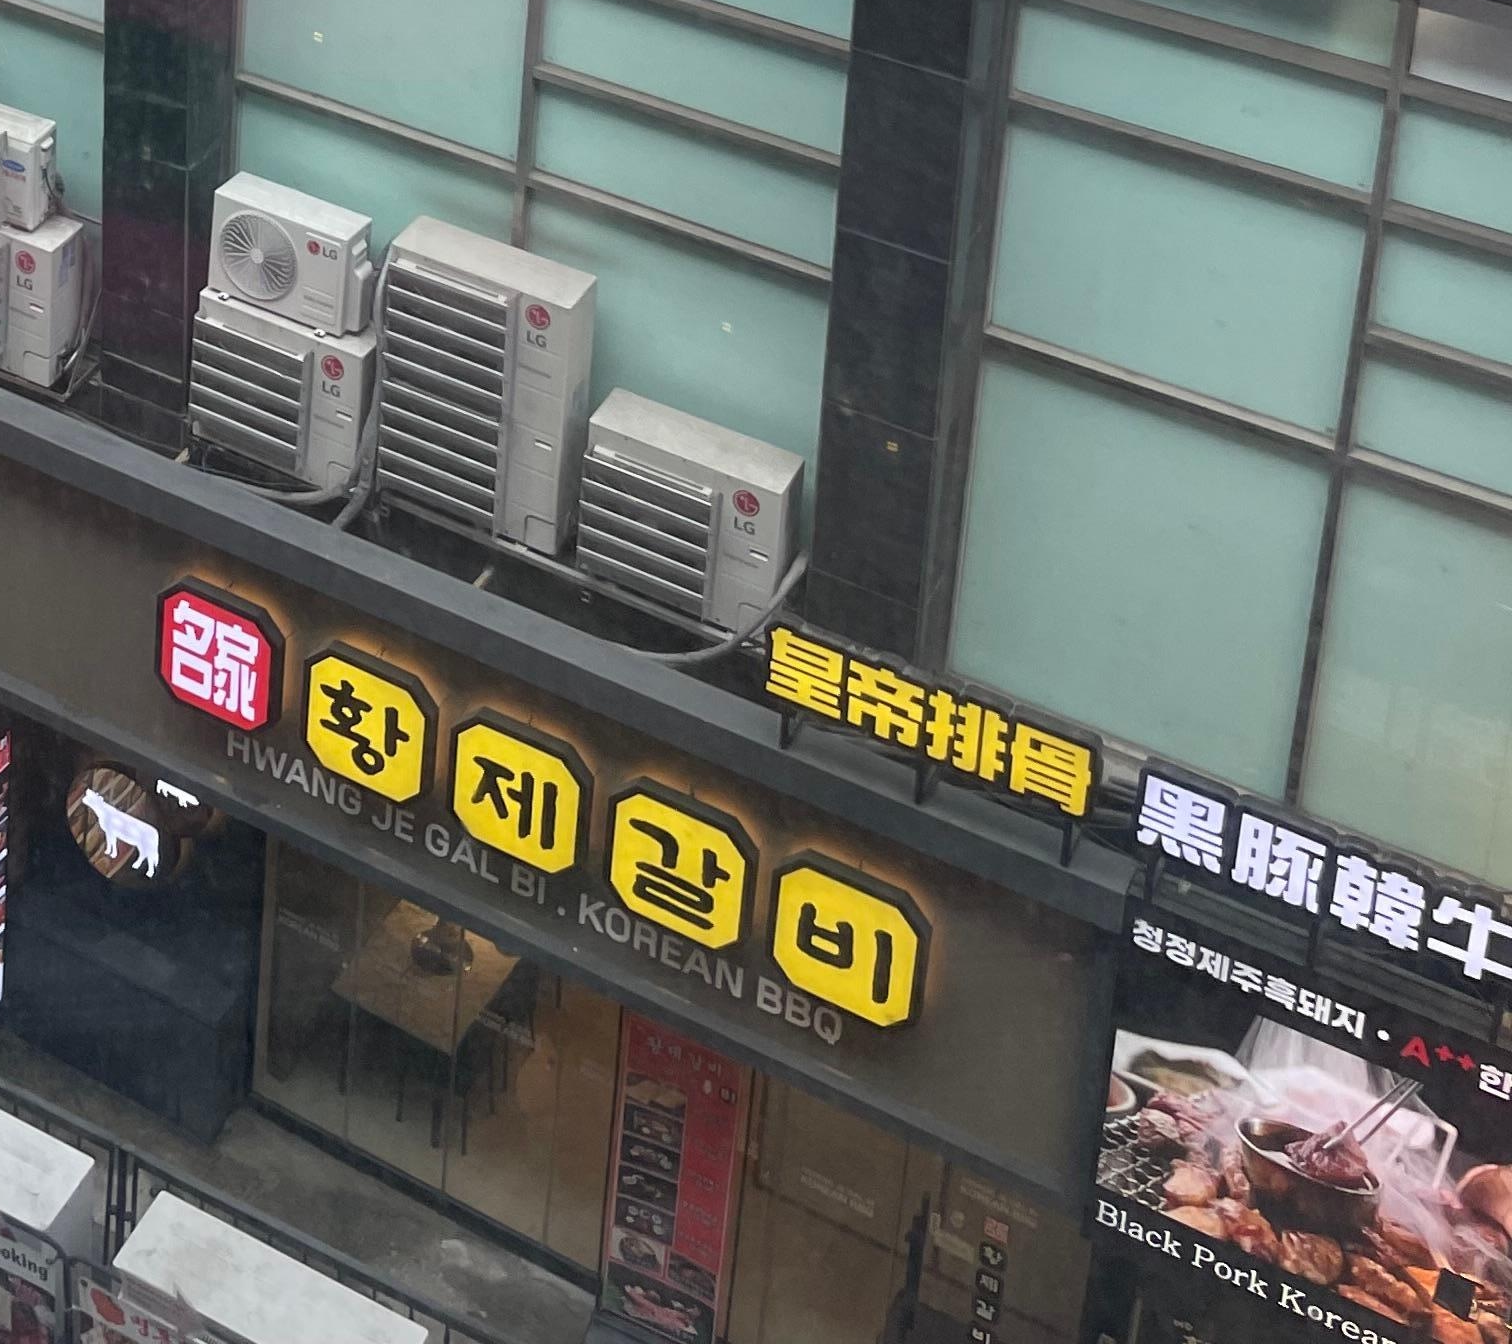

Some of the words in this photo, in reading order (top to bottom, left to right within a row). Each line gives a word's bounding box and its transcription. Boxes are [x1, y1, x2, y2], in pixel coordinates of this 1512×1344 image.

[16, 276, 33, 291] LG
[321, 246, 338, 262] LG
[321, 381, 342, 400] LG
[526, 330, 548, 350] LG
[733, 516, 756, 536] LG
[168, 596, 261, 725] 名家
[764, 625, 1092, 818] 皇帝排骨
[226, 732, 364, 818] HWANG
[371, 790, 414, 843] JE
[423, 822, 500, 886] GAL
[510, 865, 550, 908] BI
[576, 892, 744, 1001] KOREAN
[755, 971, 844, 1047] BBQ
[318, 679, 893, 1006] 황제갈비
[1132, 916, 1365, 1040] 청정제주흑돼지
[1095, 1199, 1182, 1260] Black
[1191, 1243, 1269, 1300] Pork
